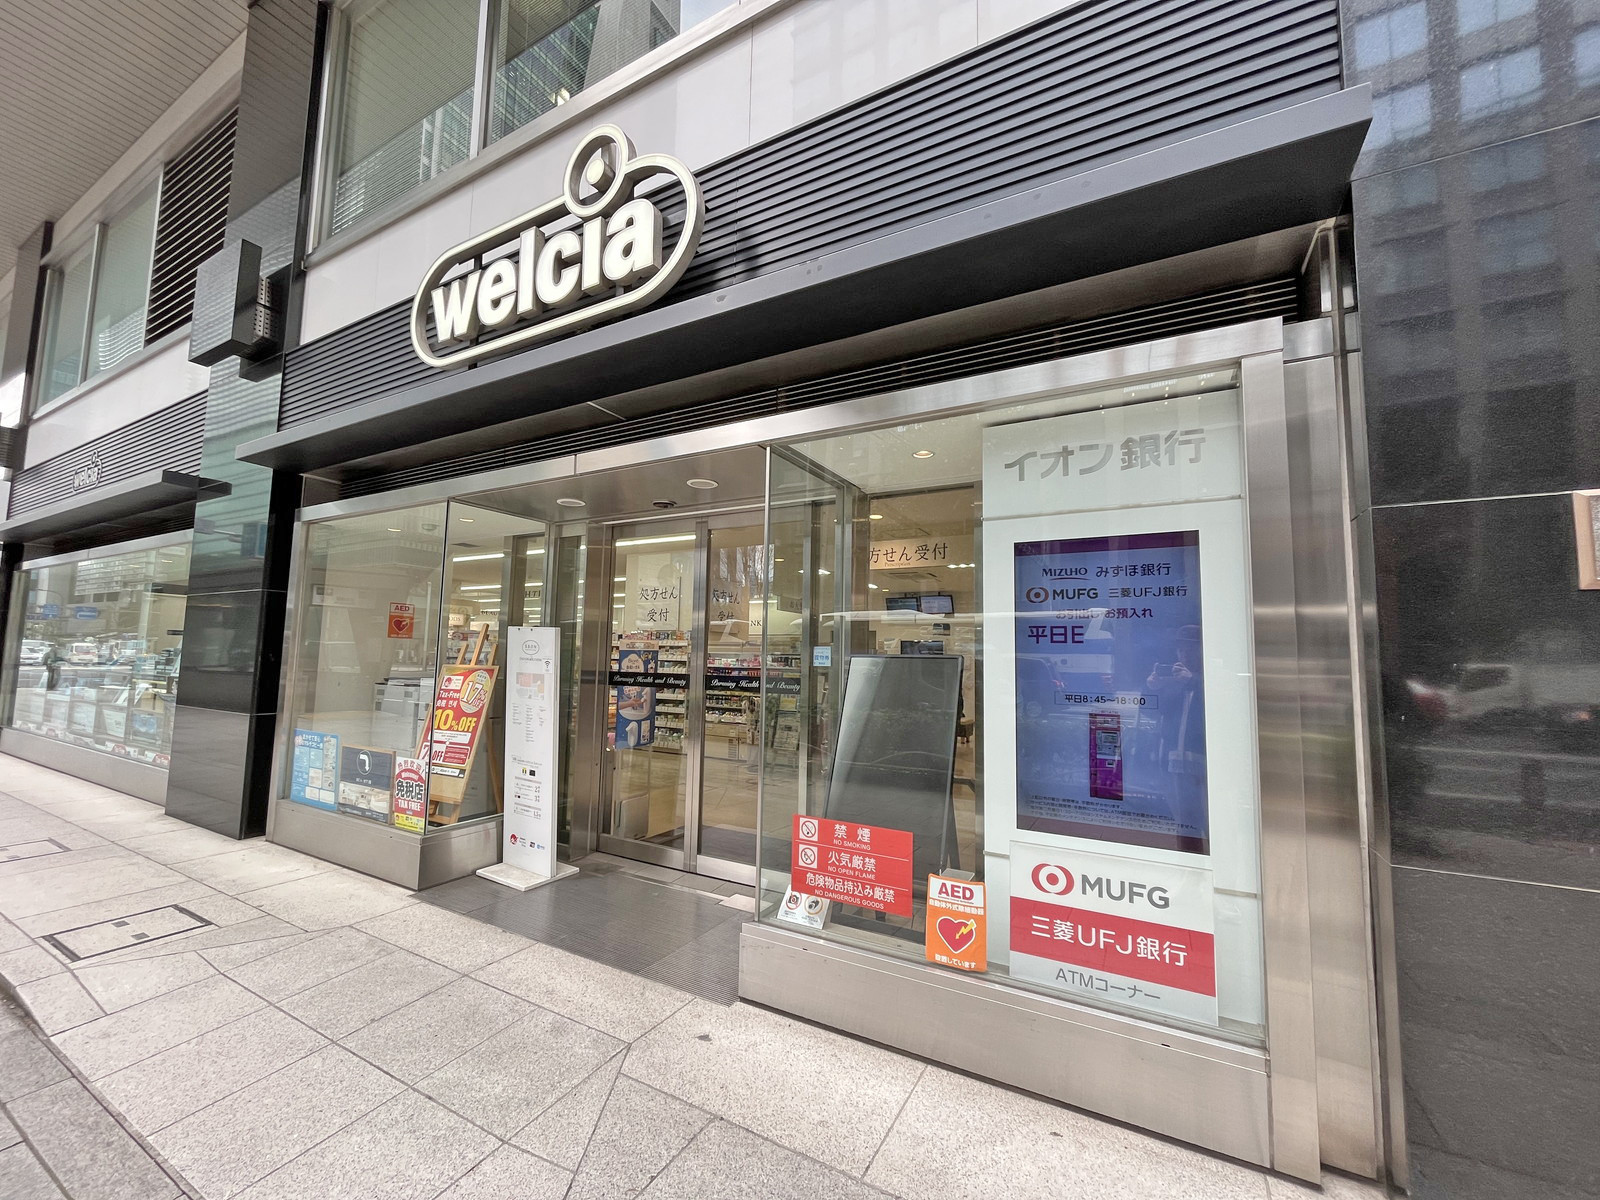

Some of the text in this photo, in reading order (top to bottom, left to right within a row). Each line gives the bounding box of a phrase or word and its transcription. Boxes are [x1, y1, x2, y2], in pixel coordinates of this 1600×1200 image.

[431, 199, 662, 343] welcia
[1004, 428, 1206, 481] イオン銀行
[1041, 562, 1172, 578] MIZUHO みずほ銀行
[639, 586, 679, 601] 処方せん
[1052, 585, 1188, 600] MUFG 三菱UFJ銀行
[646, 608, 670, 622] 受付
[1104, 608, 1154, 619] お預入れ
[395, 780, 424, 802] 免税店
[397, 800, 421, 812] TAX FREE
[843, 841, 871, 851] SMOKING
[828, 850, 876, 873] 火気厳禁
[837, 868, 854, 876] OPEN
[855, 871, 876, 880] FLAME
[805, 872, 895, 904] 危険物品持込み厳禁
[937, 882, 975, 901] AED
[1081, 873, 1170, 909] MUFG
[824, 891, 861, 905] DANGEROUS
[861, 900, 884, 909] GOODS
[1031, 915, 1188, 967] 三菱UFJ銀行
[1055, 968, 1161, 1000] ATMコーナー
